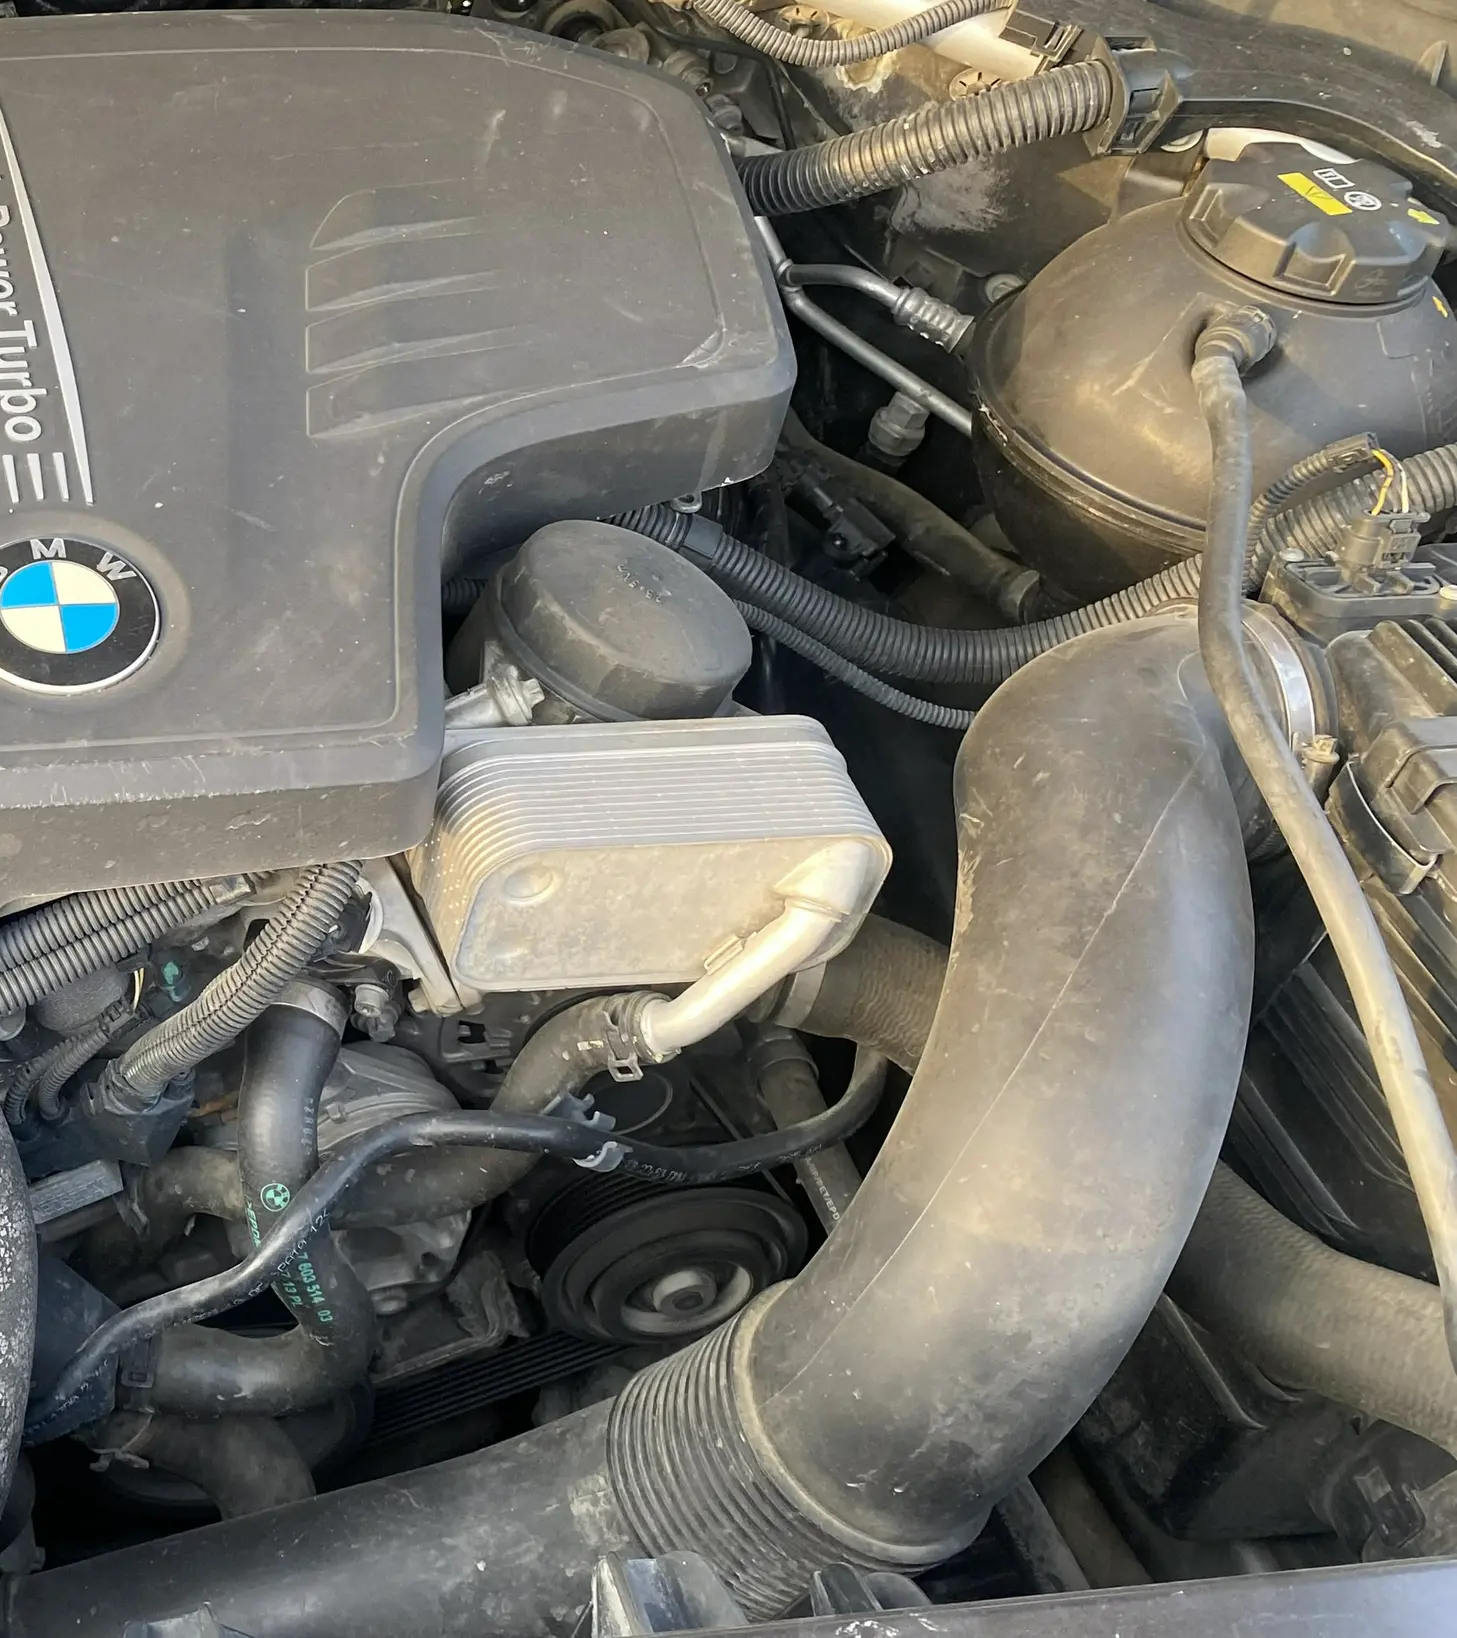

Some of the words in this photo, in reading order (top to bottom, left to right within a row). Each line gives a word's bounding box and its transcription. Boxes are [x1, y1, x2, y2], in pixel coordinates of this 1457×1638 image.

[298, 1262, 317, 1285] 603
[306, 1283, 327, 1305] 514
[317, 1308, 334, 1324] 03
